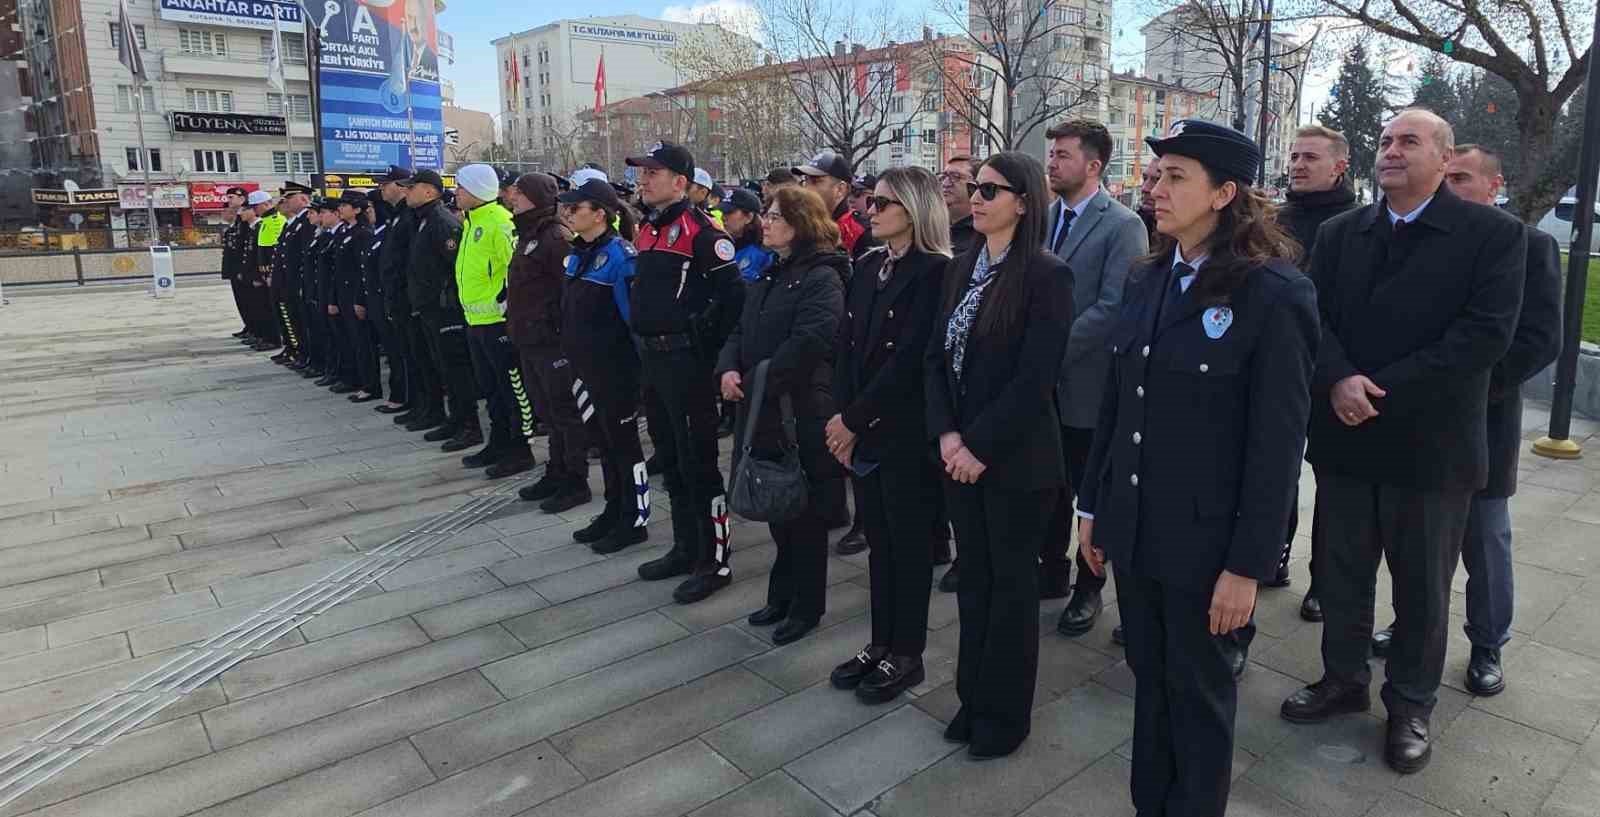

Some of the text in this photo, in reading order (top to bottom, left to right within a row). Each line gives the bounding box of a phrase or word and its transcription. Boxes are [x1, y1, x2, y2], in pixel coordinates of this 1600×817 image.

[167, 0, 249, 15] ANAHTAR
[353, 5, 377, 35] A
[175, 113, 252, 132] TUYENA
